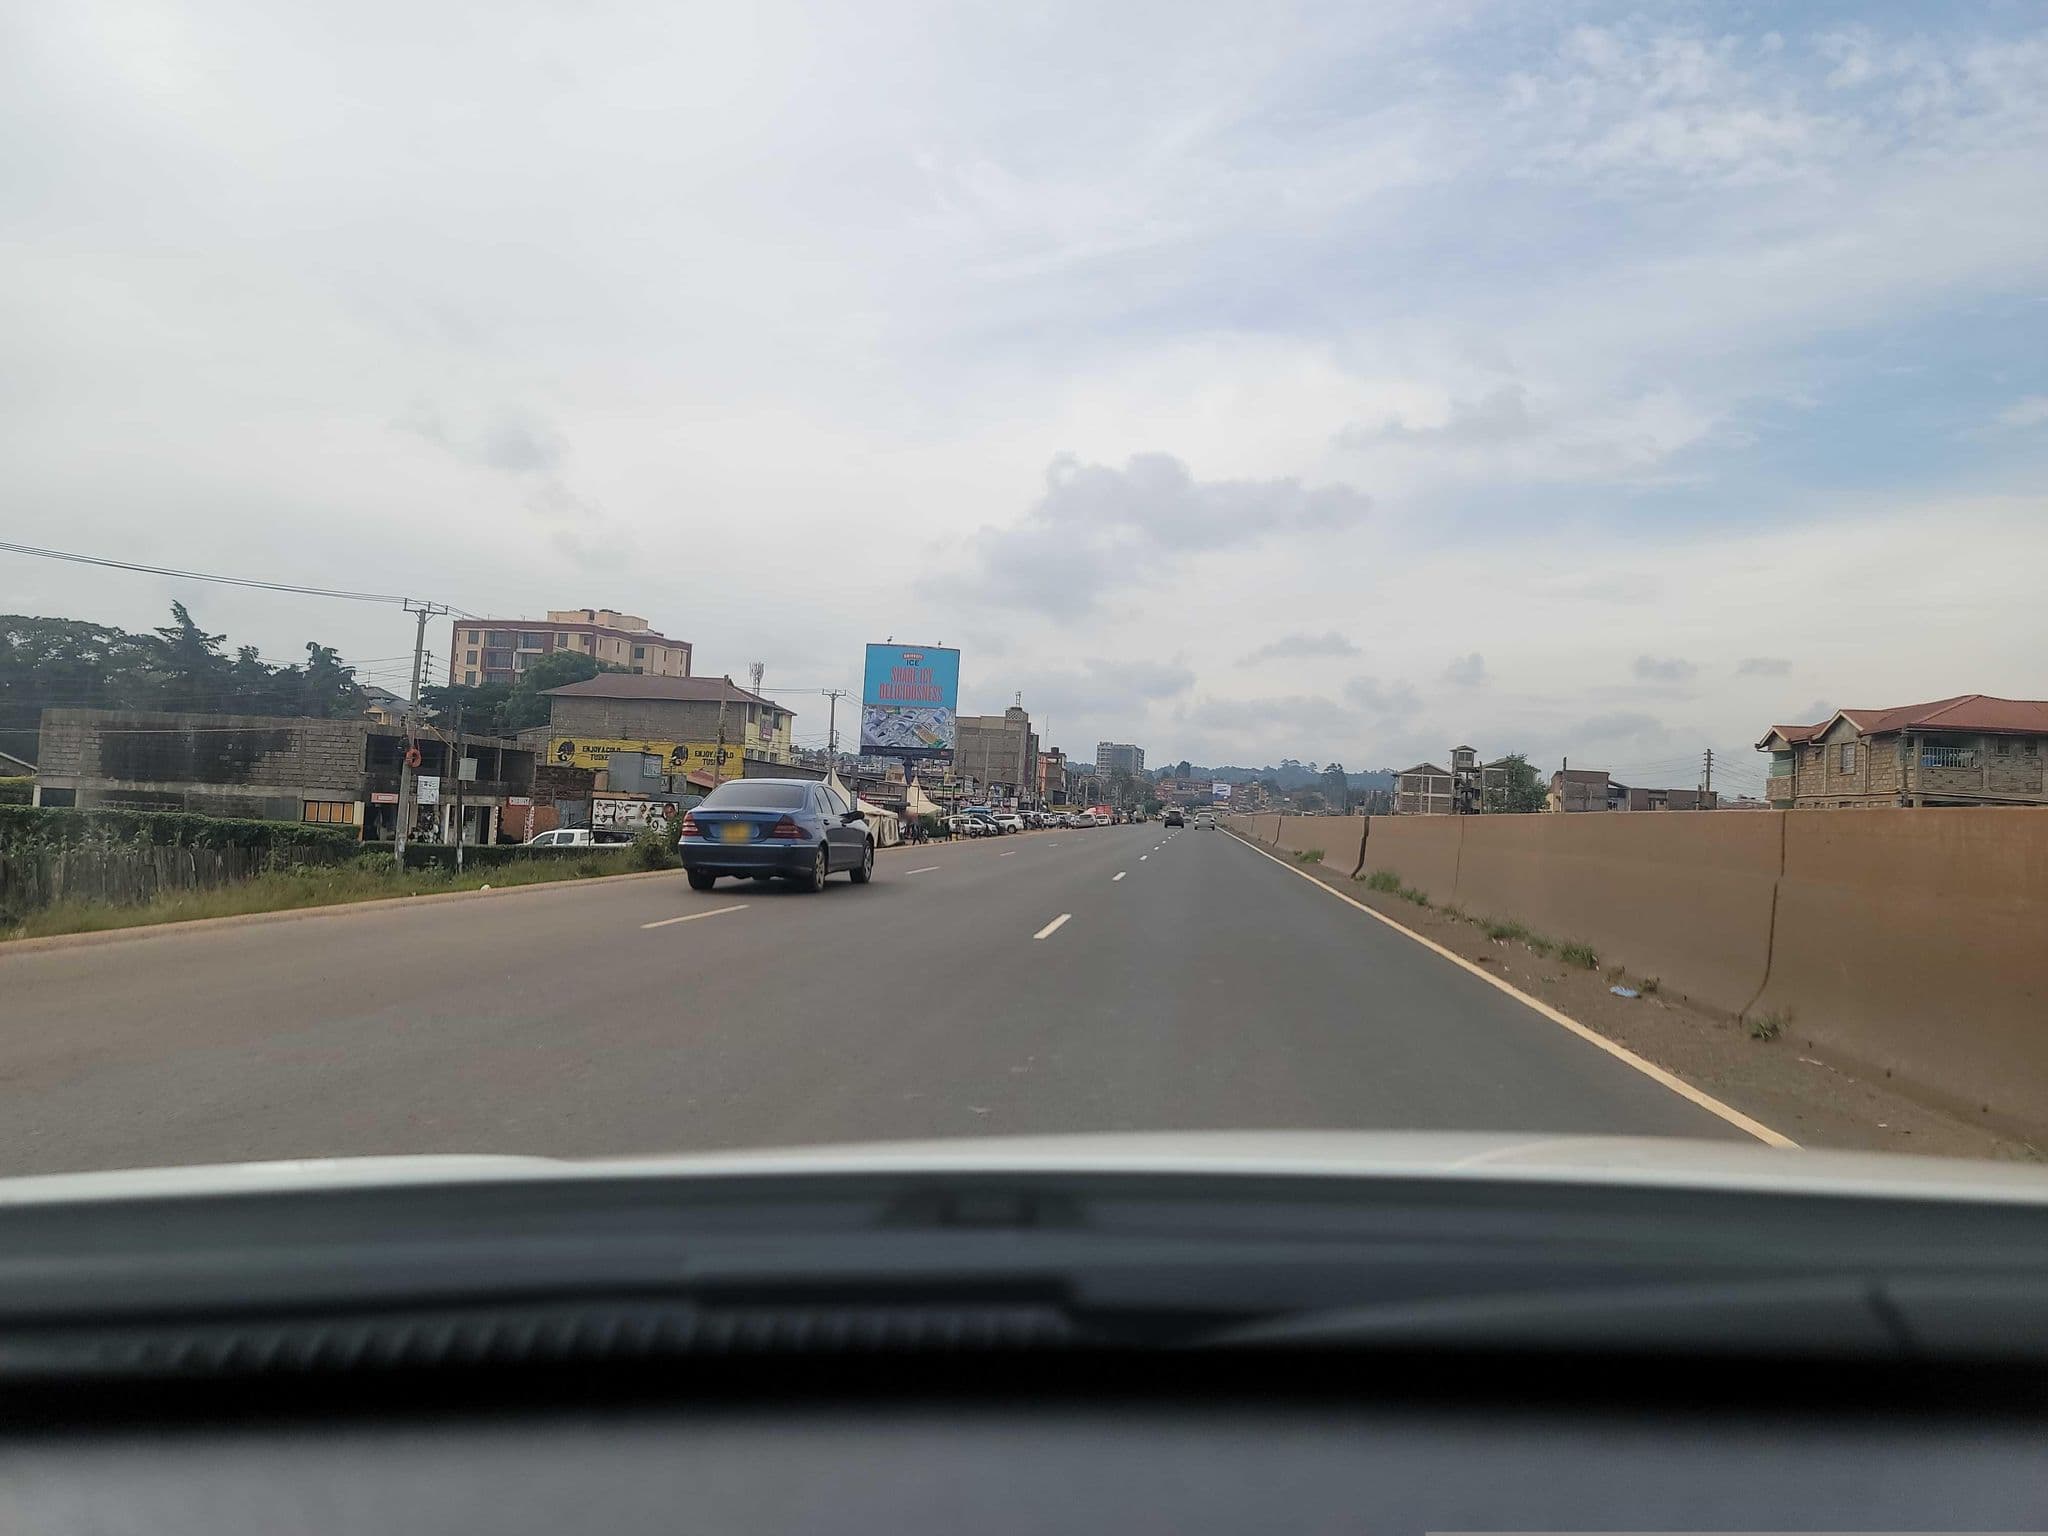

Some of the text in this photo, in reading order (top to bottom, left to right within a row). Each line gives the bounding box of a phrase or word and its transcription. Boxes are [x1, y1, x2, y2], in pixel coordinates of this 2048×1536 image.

[906, 659, 919, 667] ICE
[920, 667, 934, 684] ICY
[880, 683, 943, 702] DELICIOUSNESS
[582, 745, 601, 753] ENJOY
